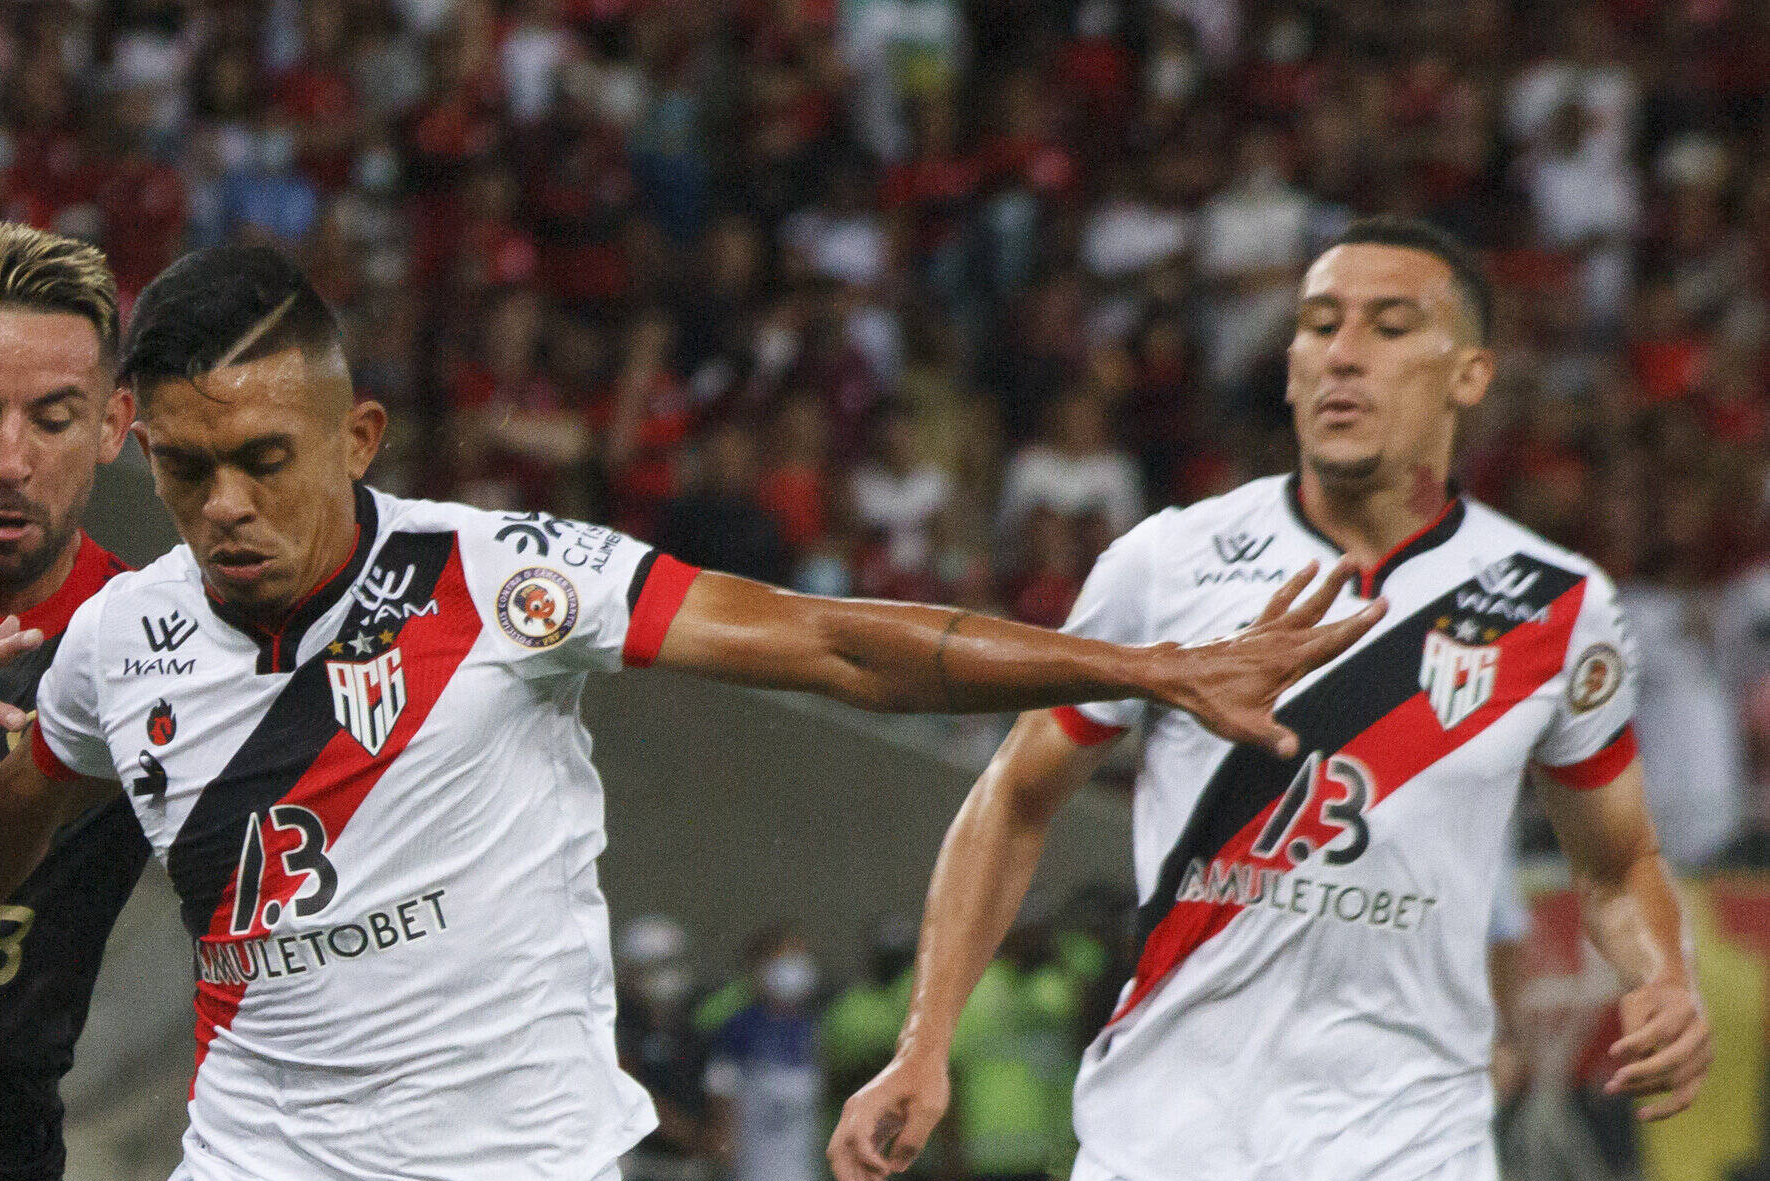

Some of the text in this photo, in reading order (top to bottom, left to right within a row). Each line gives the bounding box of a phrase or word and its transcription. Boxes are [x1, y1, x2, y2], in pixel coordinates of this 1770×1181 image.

[591, 533, 623, 574] ALIME
[123, 658, 197, 676] WAM
[326, 645, 408, 757] ACG
[1175, 857, 1437, 930] AMULETOBET
